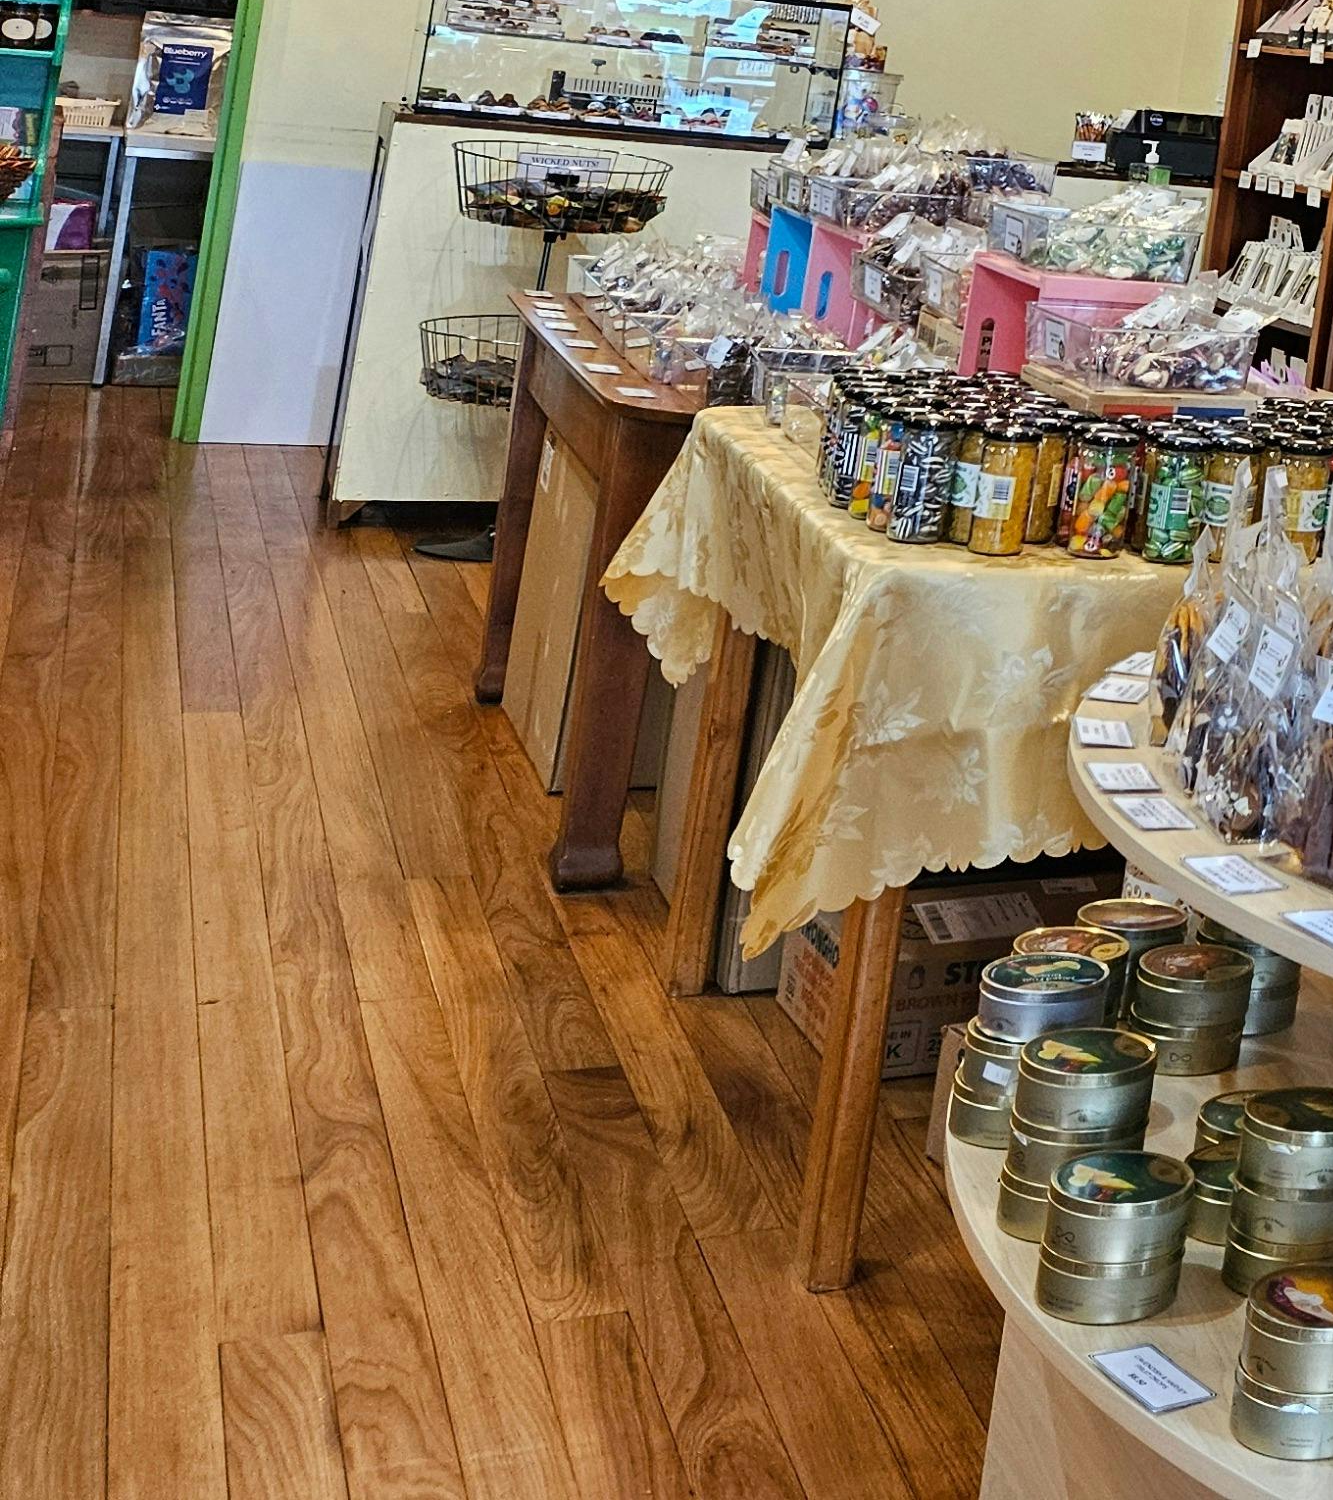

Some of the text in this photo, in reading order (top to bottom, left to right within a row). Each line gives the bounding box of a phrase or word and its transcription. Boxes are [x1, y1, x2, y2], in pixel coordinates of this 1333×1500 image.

[163, 46, 208, 59] Blueberry
[531, 156, 600, 168] WICKED NUTS!
